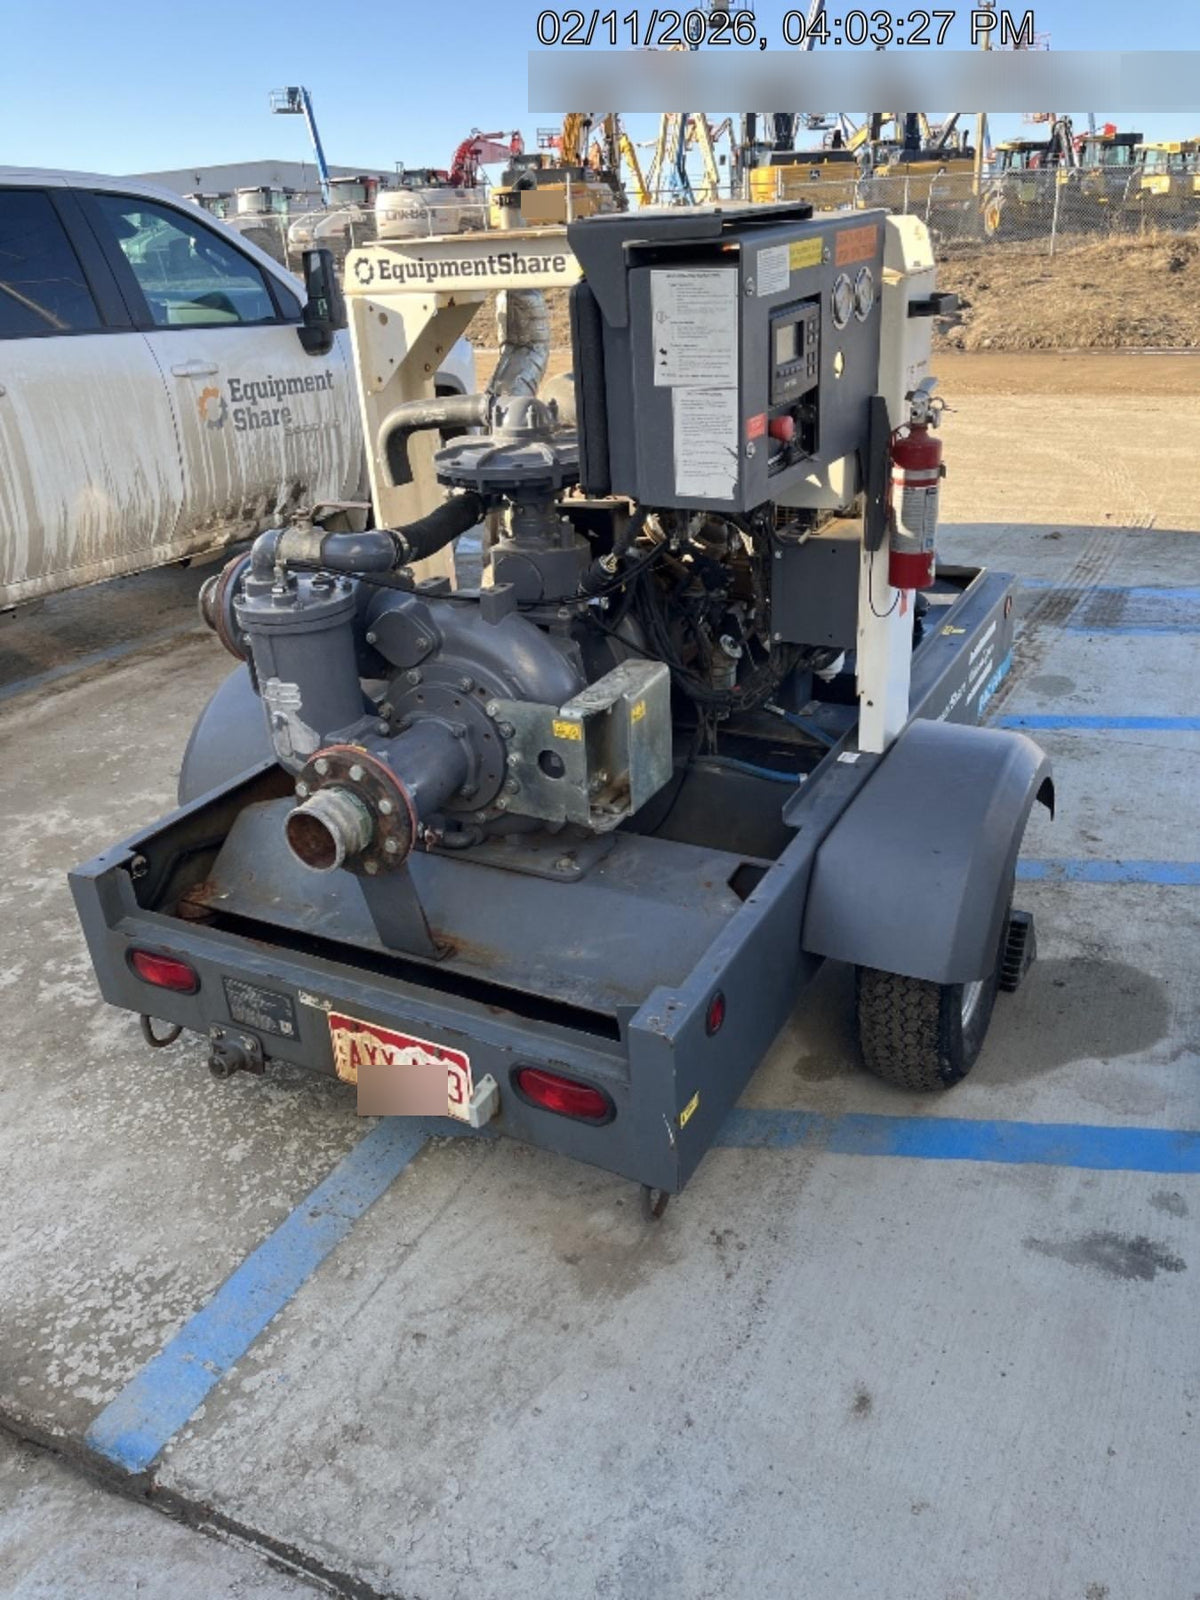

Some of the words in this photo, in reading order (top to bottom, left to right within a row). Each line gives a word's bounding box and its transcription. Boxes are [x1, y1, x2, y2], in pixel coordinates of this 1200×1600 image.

[377, 253, 566, 283] EquipmentShare
[228, 369, 334, 405] Equipment
[233, 406, 292, 431] Share
